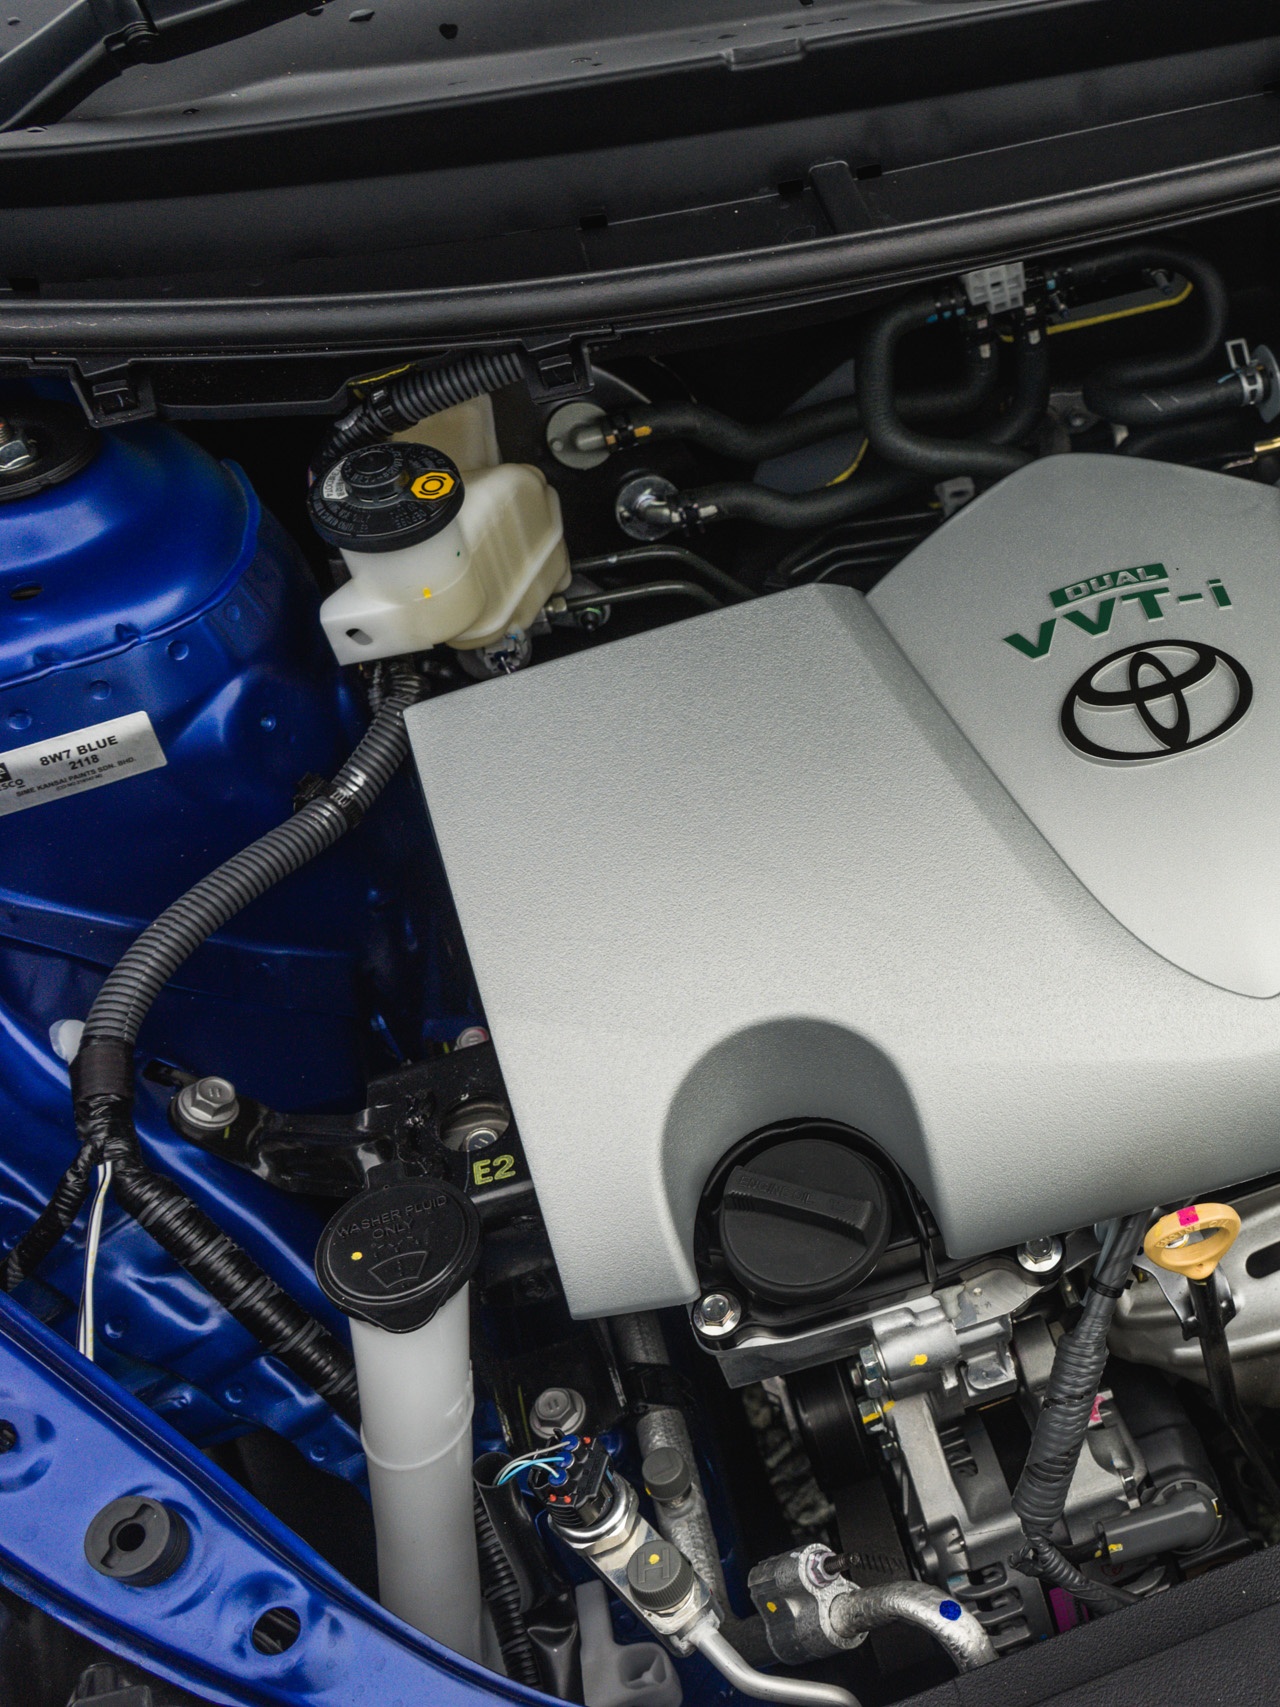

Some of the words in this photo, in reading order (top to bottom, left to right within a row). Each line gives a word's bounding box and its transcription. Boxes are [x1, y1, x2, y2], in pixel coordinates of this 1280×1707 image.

[1062, 565, 1161, 602] DUAL
[1002, 578, 1233, 663] VVT-i
[39, 748, 72, 767] 8W7
[76, 734, 119, 756] BLUE
[68, 754, 100, 771] 2118
[36, 776, 68, 792] KANSAI
[68, 769, 97, 783] PAINTS
[472, 1154, 516, 1186] E2
[335, 1209, 401, 1238] WASHER
[404, 1195, 448, 1217] FLUID
[372, 1218, 414, 1240] ONLY
